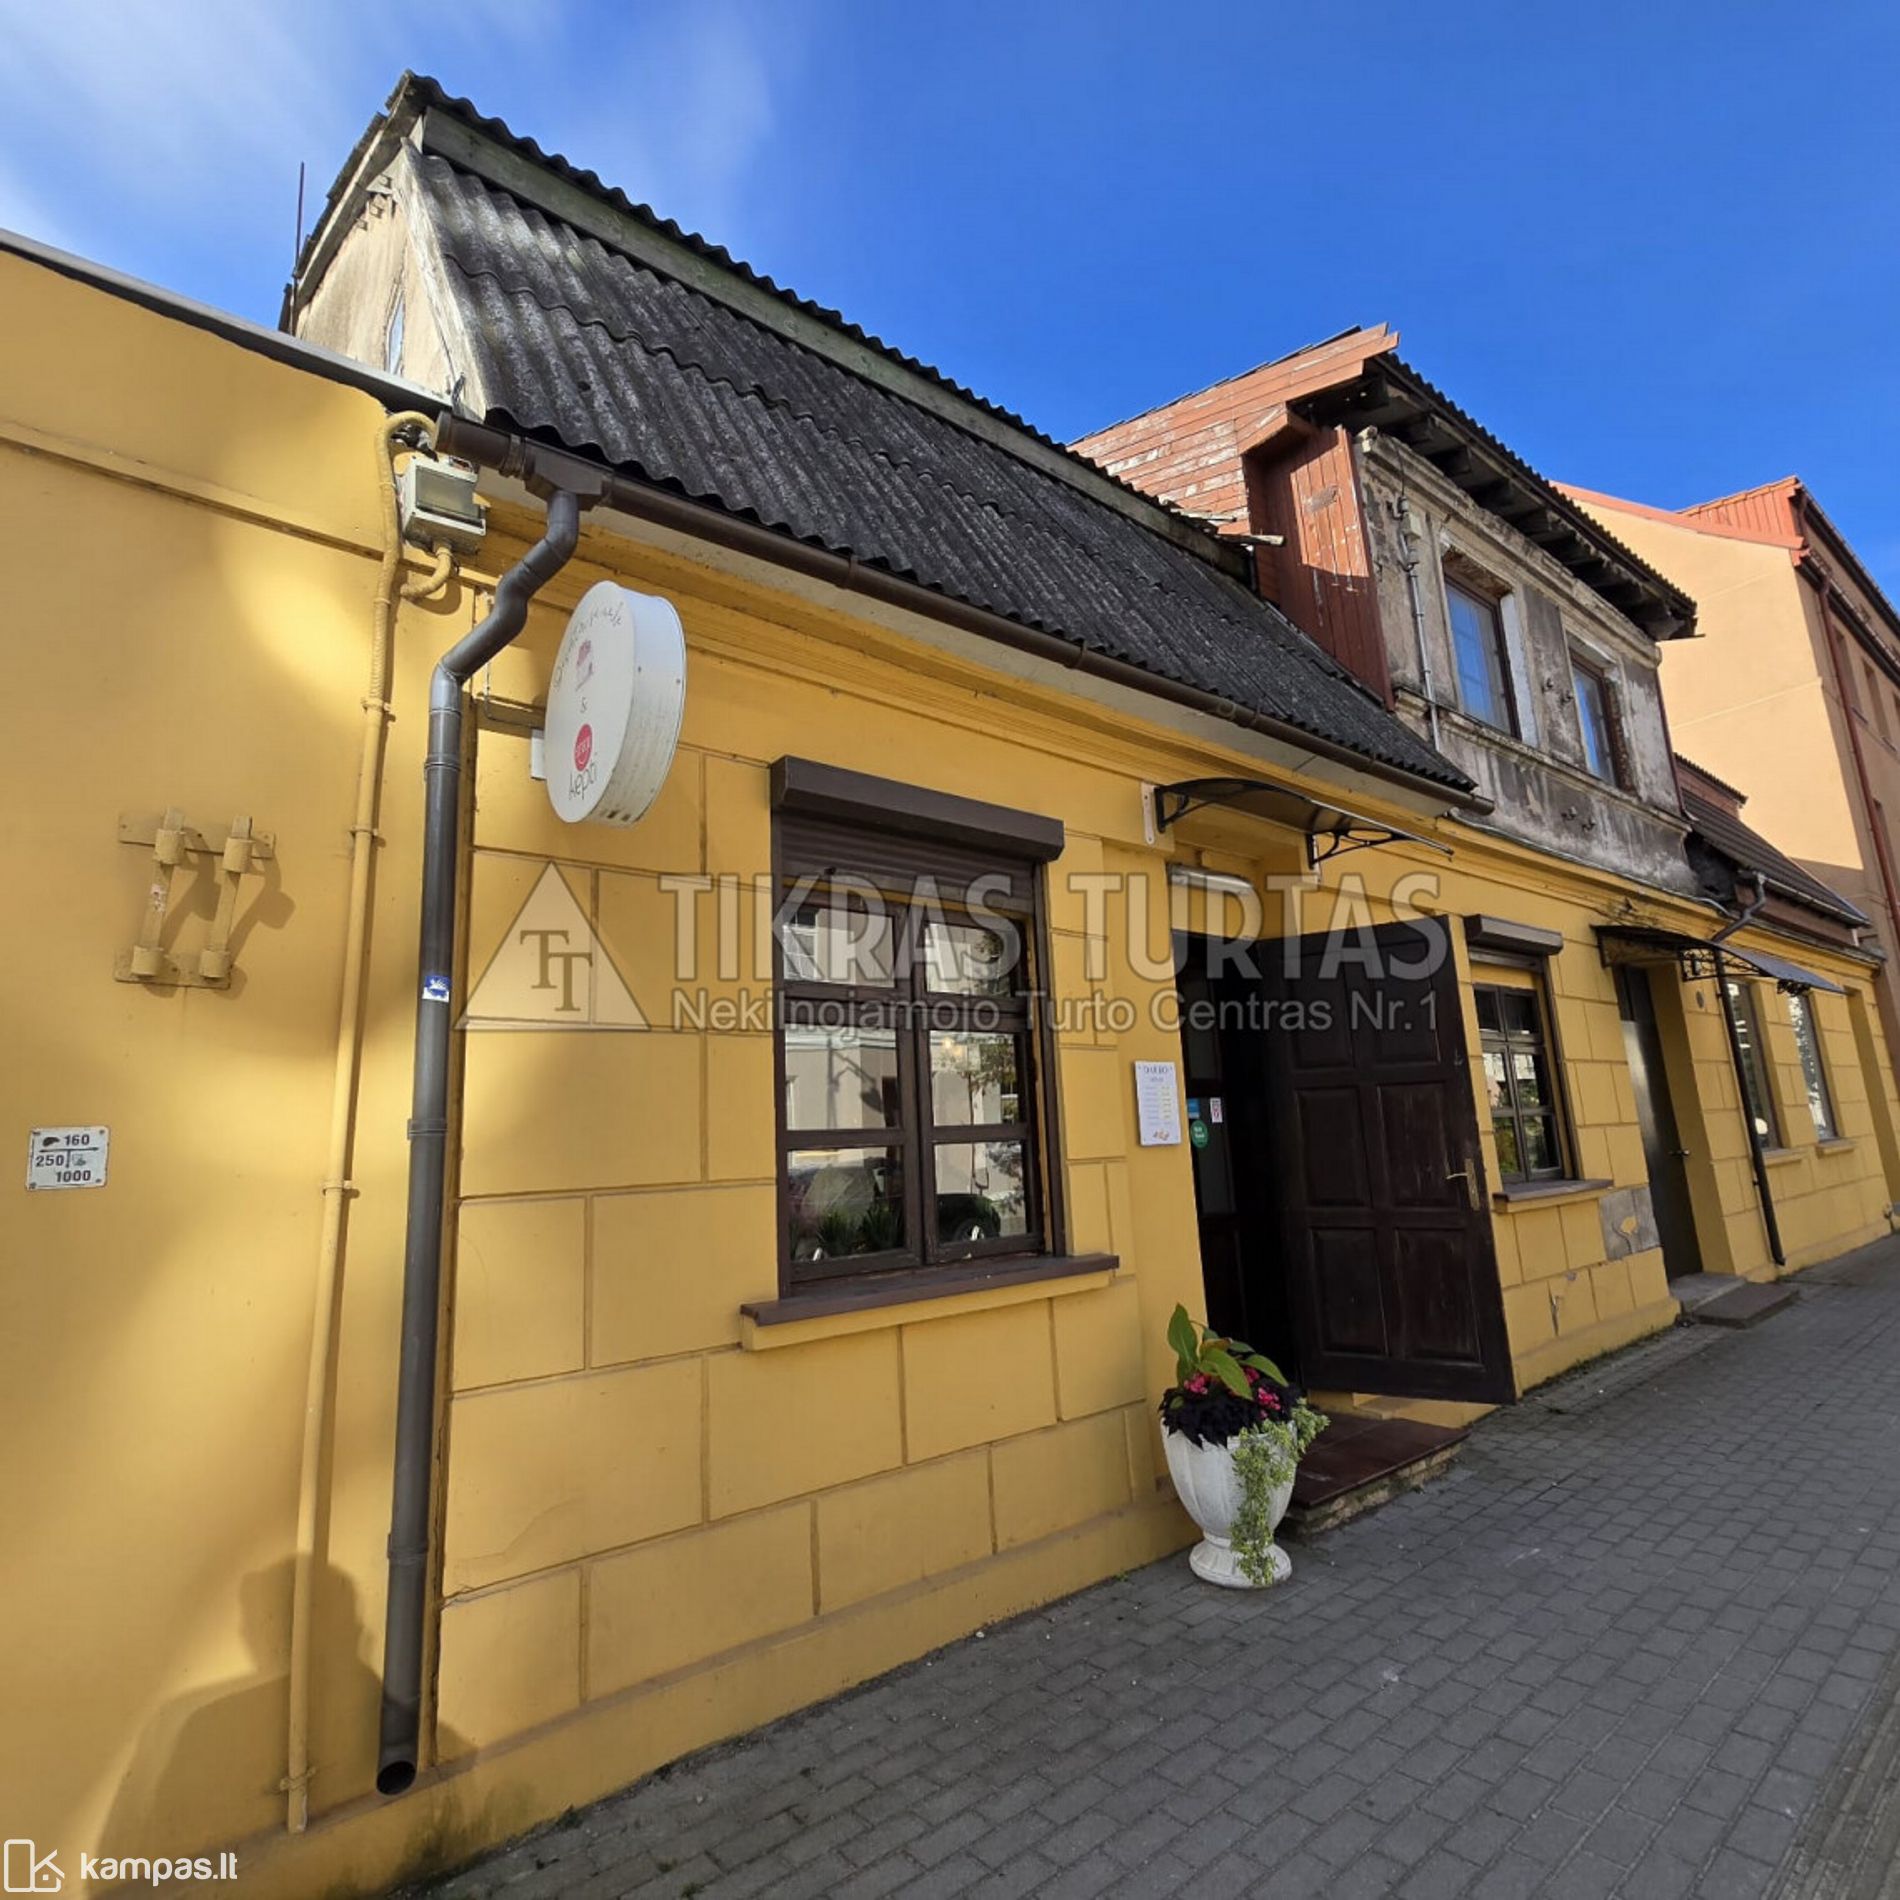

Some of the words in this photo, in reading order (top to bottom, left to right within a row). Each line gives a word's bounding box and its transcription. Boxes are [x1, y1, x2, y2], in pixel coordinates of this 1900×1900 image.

[64, 1134, 90, 1146] 160
[35, 1154, 65, 1168] 250
[56, 1170, 91, 1183] 1000
